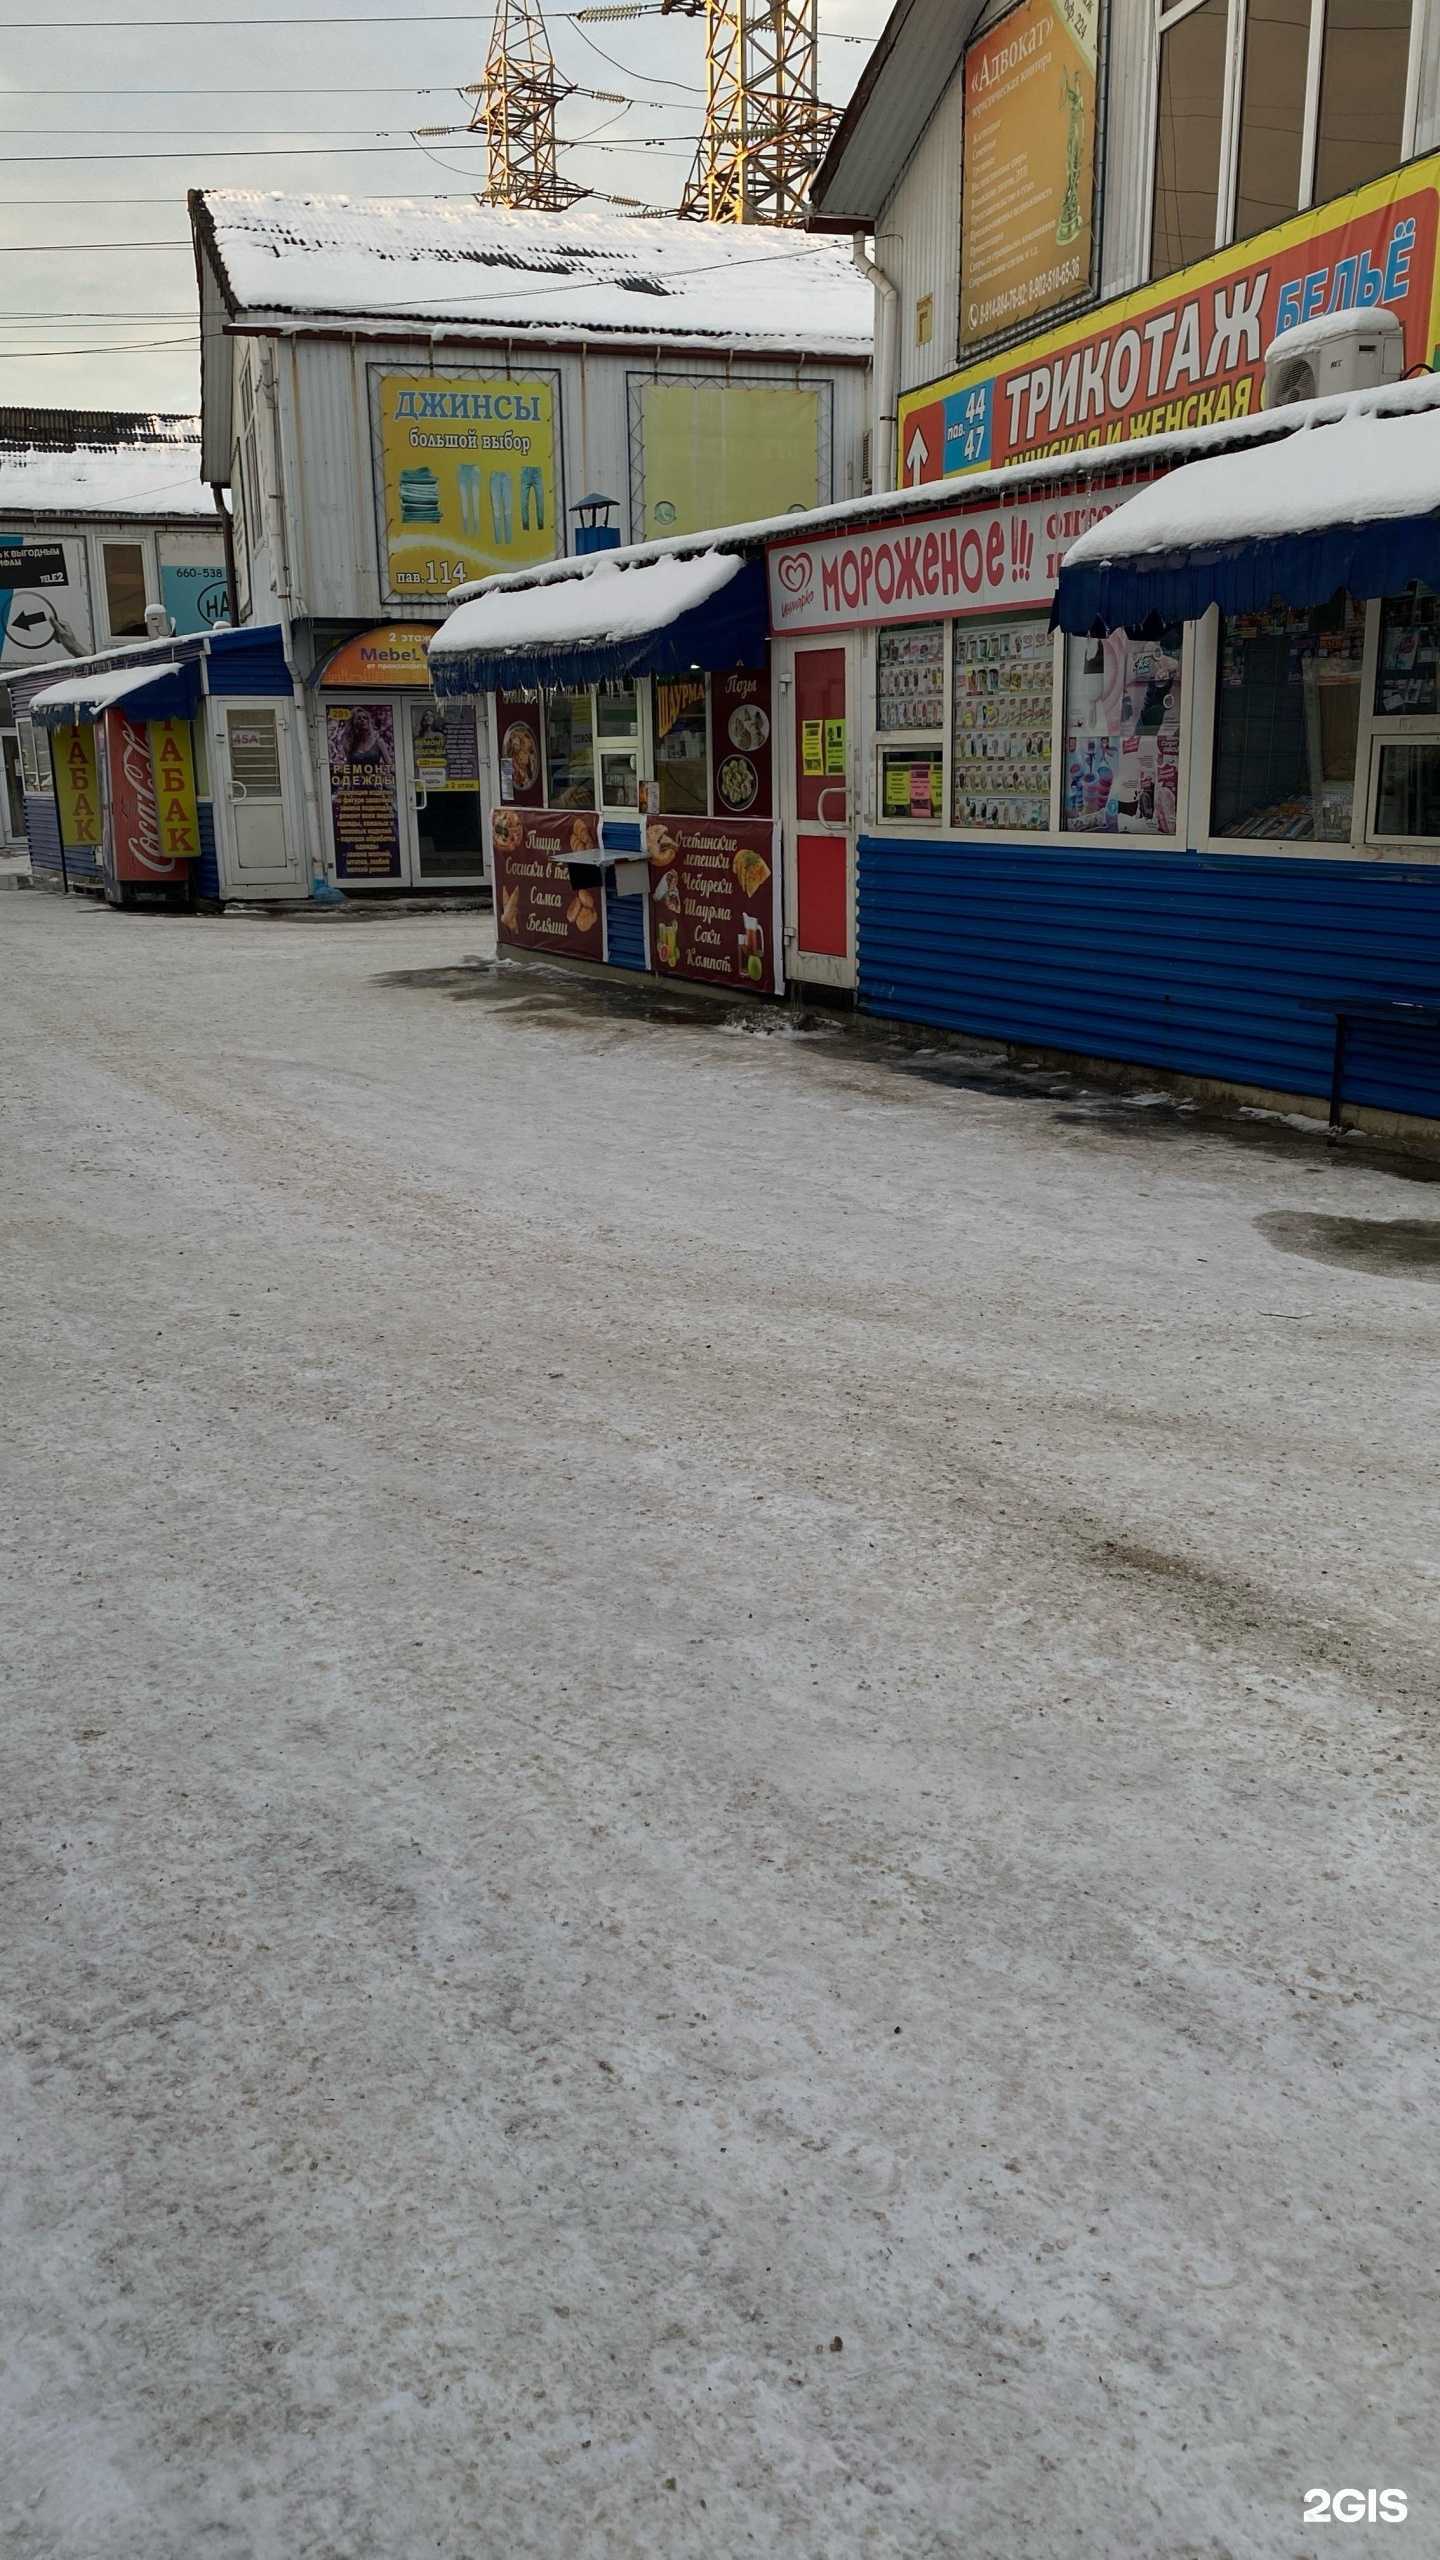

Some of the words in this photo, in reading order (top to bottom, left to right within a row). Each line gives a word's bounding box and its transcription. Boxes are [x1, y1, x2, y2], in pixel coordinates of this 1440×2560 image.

[1275, 216, 1417, 338] БЕЛЬЁ
[1006, 272, 1271, 446] ТРИКОТАЖ
[394, 391, 541, 421] ДЖИНСЫ
[965, 387, 986, 424] 44
[1129, 377, 1252, 441] ЖЕНСКАЯ
[409, 427, 478, 450] большой
[482, 430, 531, 455] выбор
[947, 423, 966, 441] пав.
[964, 425, 985, 461] 47
[40, 572, 64, 583] TELE2
[176, 568, 223, 578] 660-538
[397, 571, 424, 585] пав.
[425, 559, 467, 585] 114
[390, 632, 397, 642] 2
[724, 674, 758, 699] Позы
[656, 682, 705, 739] ШАУРМА
[331, 775, 396, 788] ОДЕЖДЫ
[333, 764, 393, 774] РЕМОНТ
[525, 829, 562, 856] Пицца
[505, 856, 545, 878] Сосиски
[530, 885, 562, 908] Самса
[681, 871, 734, 899] Чебуреки
[683, 896, 732, 924] Шаурма
[526, 912, 569, 937] Беляши
[694, 924, 722, 945] Соки
[686, 947, 732, 973] Компот
